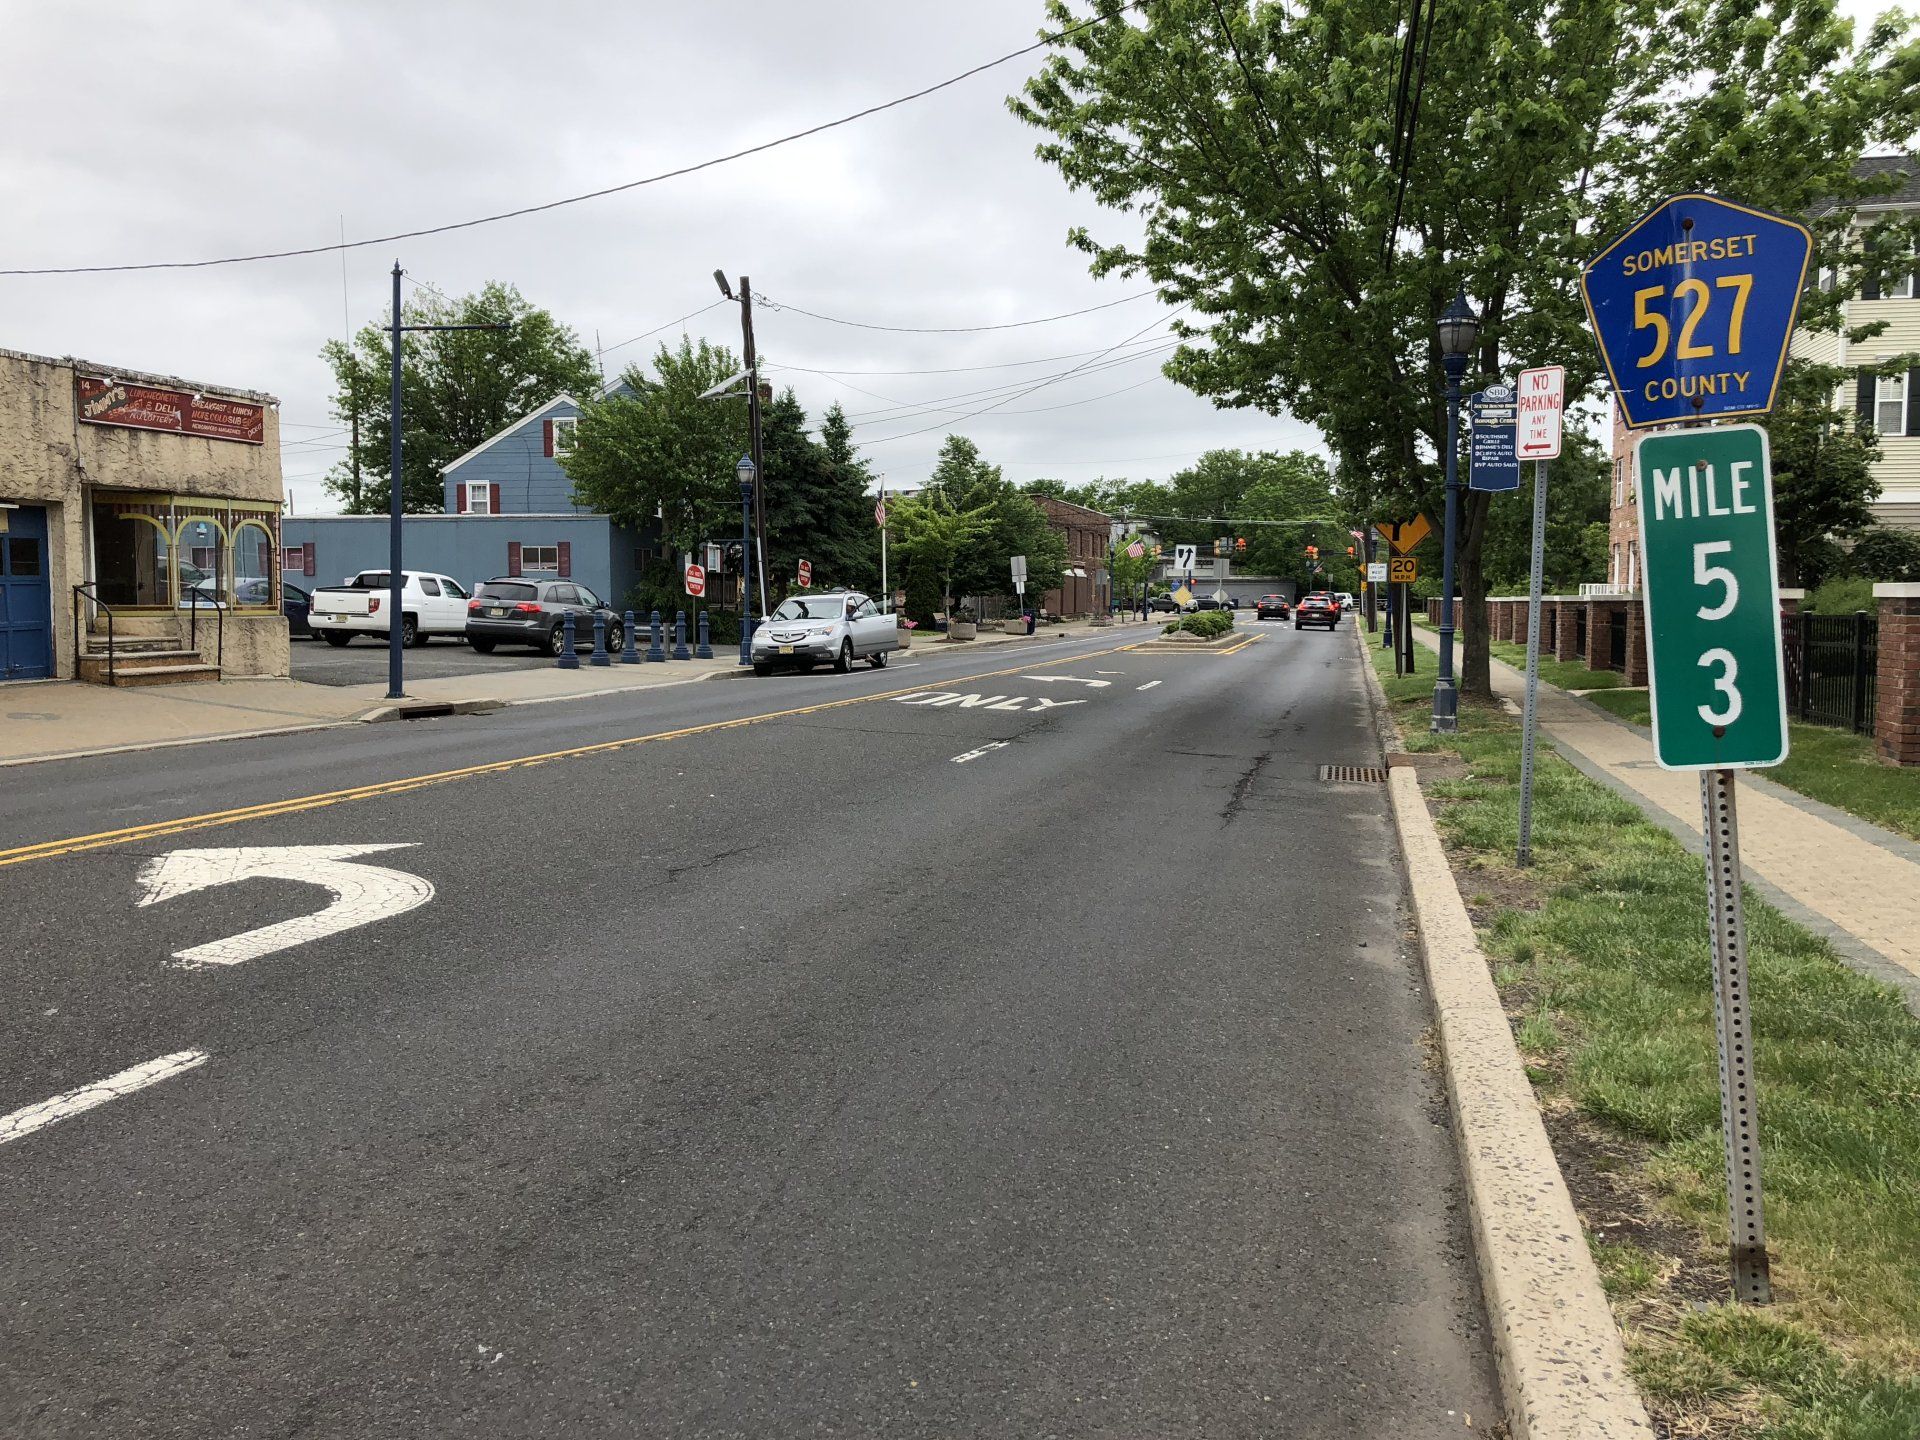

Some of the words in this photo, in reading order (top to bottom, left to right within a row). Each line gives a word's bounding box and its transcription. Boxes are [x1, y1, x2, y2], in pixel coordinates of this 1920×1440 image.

[1622, 234, 1757, 276] SOMERSET
[1634, 273, 1753, 368] 527
[81, 381, 91, 390] 14
[1532, 373, 1549, 391] NO
[1644, 371, 1750, 402] COUNTY
[129, 389, 180, 403] LUNCHEONETTE
[1520, 393, 1559, 412] PARKING
[155, 403, 175, 413] DELI
[191, 400, 227, 412] BREAKFAST
[232, 407, 253, 416] LUNCH
[143, 412, 174, 424] LOTTERY
[210, 413, 227, 423] COLD
[1532, 415, 1547, 425] ANY
[1530, 429, 1547, 439] TIME
[1652, 461, 1757, 520] MILE
[1392, 560, 1415, 572] 20
[1693, 540, 1739, 621] 5
[1696, 647, 1742, 726] 3
[889, 692, 1088, 712] ONLY
